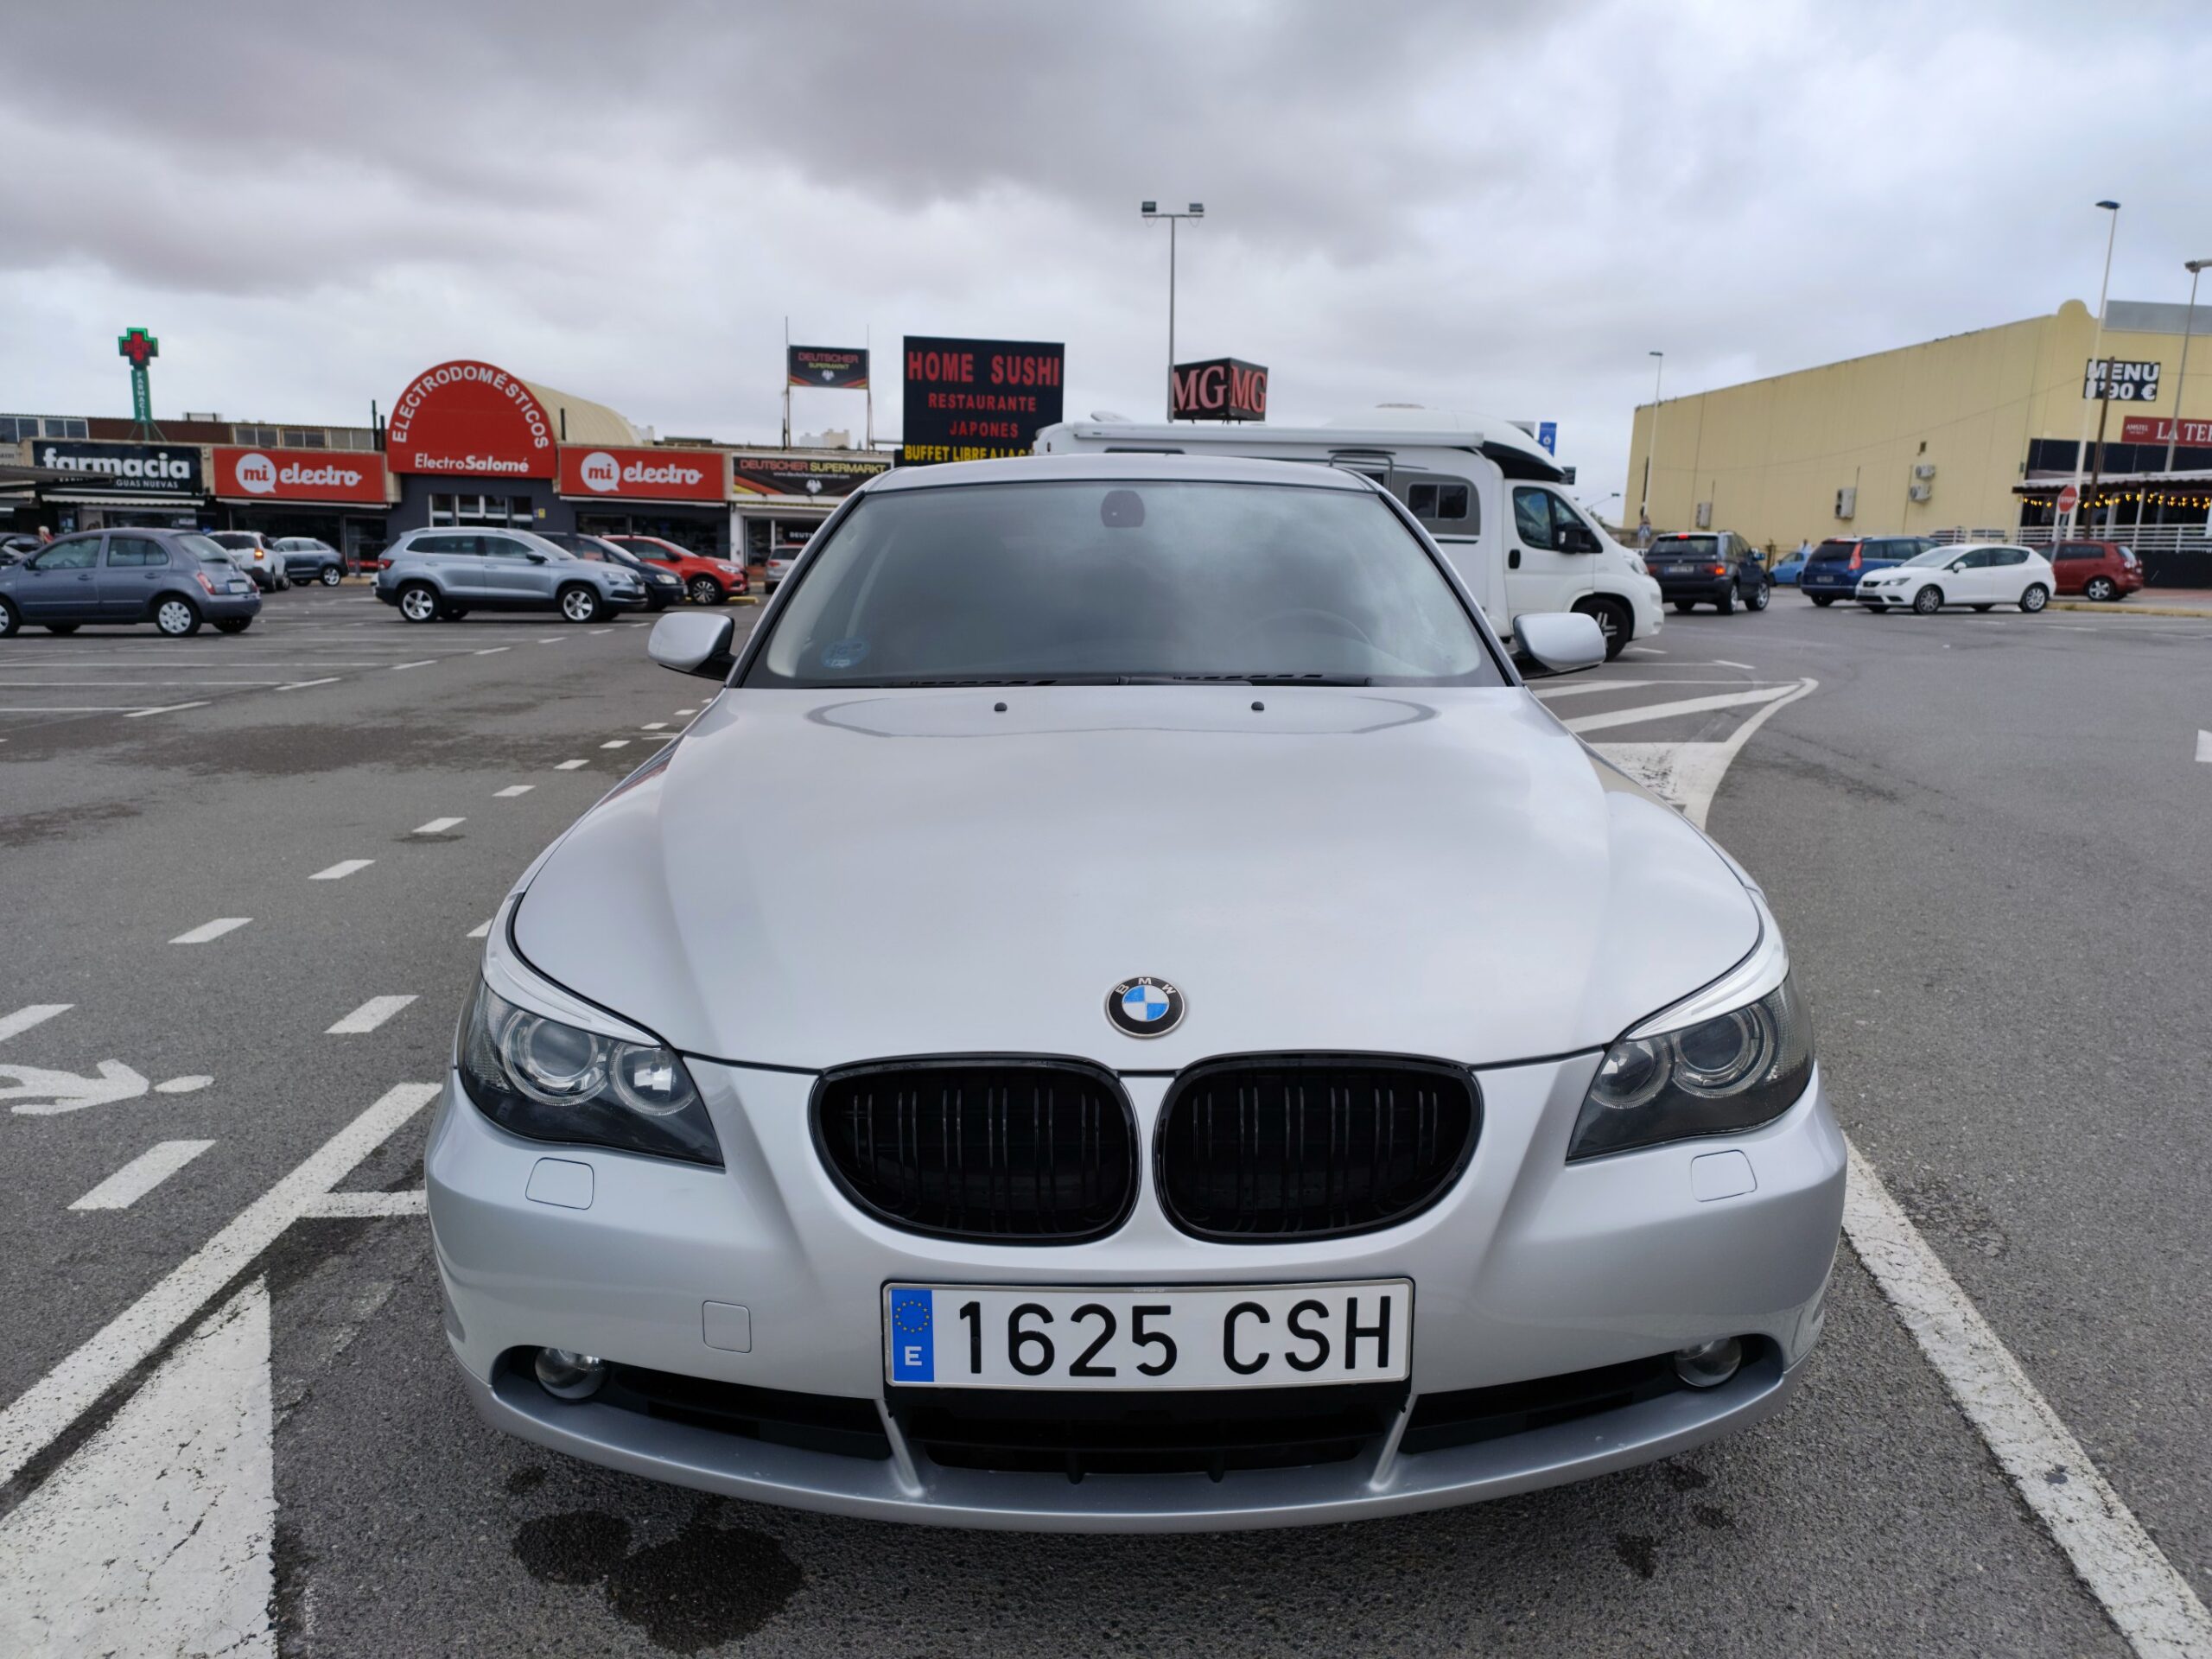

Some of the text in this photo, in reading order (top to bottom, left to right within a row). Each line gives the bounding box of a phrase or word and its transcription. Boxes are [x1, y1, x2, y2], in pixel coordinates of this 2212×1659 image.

[798, 352, 859, 363] DEUTSCHER
[908, 351, 1059, 386] HOME SUSHI
[137, 371, 146, 422] FARMACIA
[1173, 365, 1227, 411] MG
[1230, 365, 1267, 413] MG
[392, 365, 550, 449] ELECTRODOMÉSTICOS
[928, 392, 1037, 412] RESTAURANTE
[950, 421, 1019, 439] JAPONES
[43, 447, 192, 480] farmacia
[414, 453, 530, 474] ElectroSalomé
[904, 444, 950, 461] BUFFET
[243, 461, 363, 487] mi electro
[588, 461, 704, 486] mi electro
[740, 460, 887, 474] DEUTSCHER SUPERMARKT
[143, 480, 179, 489] NUEVAS
[1115, 977, 1177, 995] BMW
[958, 1295, 1391, 1378] 1625 CSH
[905, 1346, 923, 1366] E
